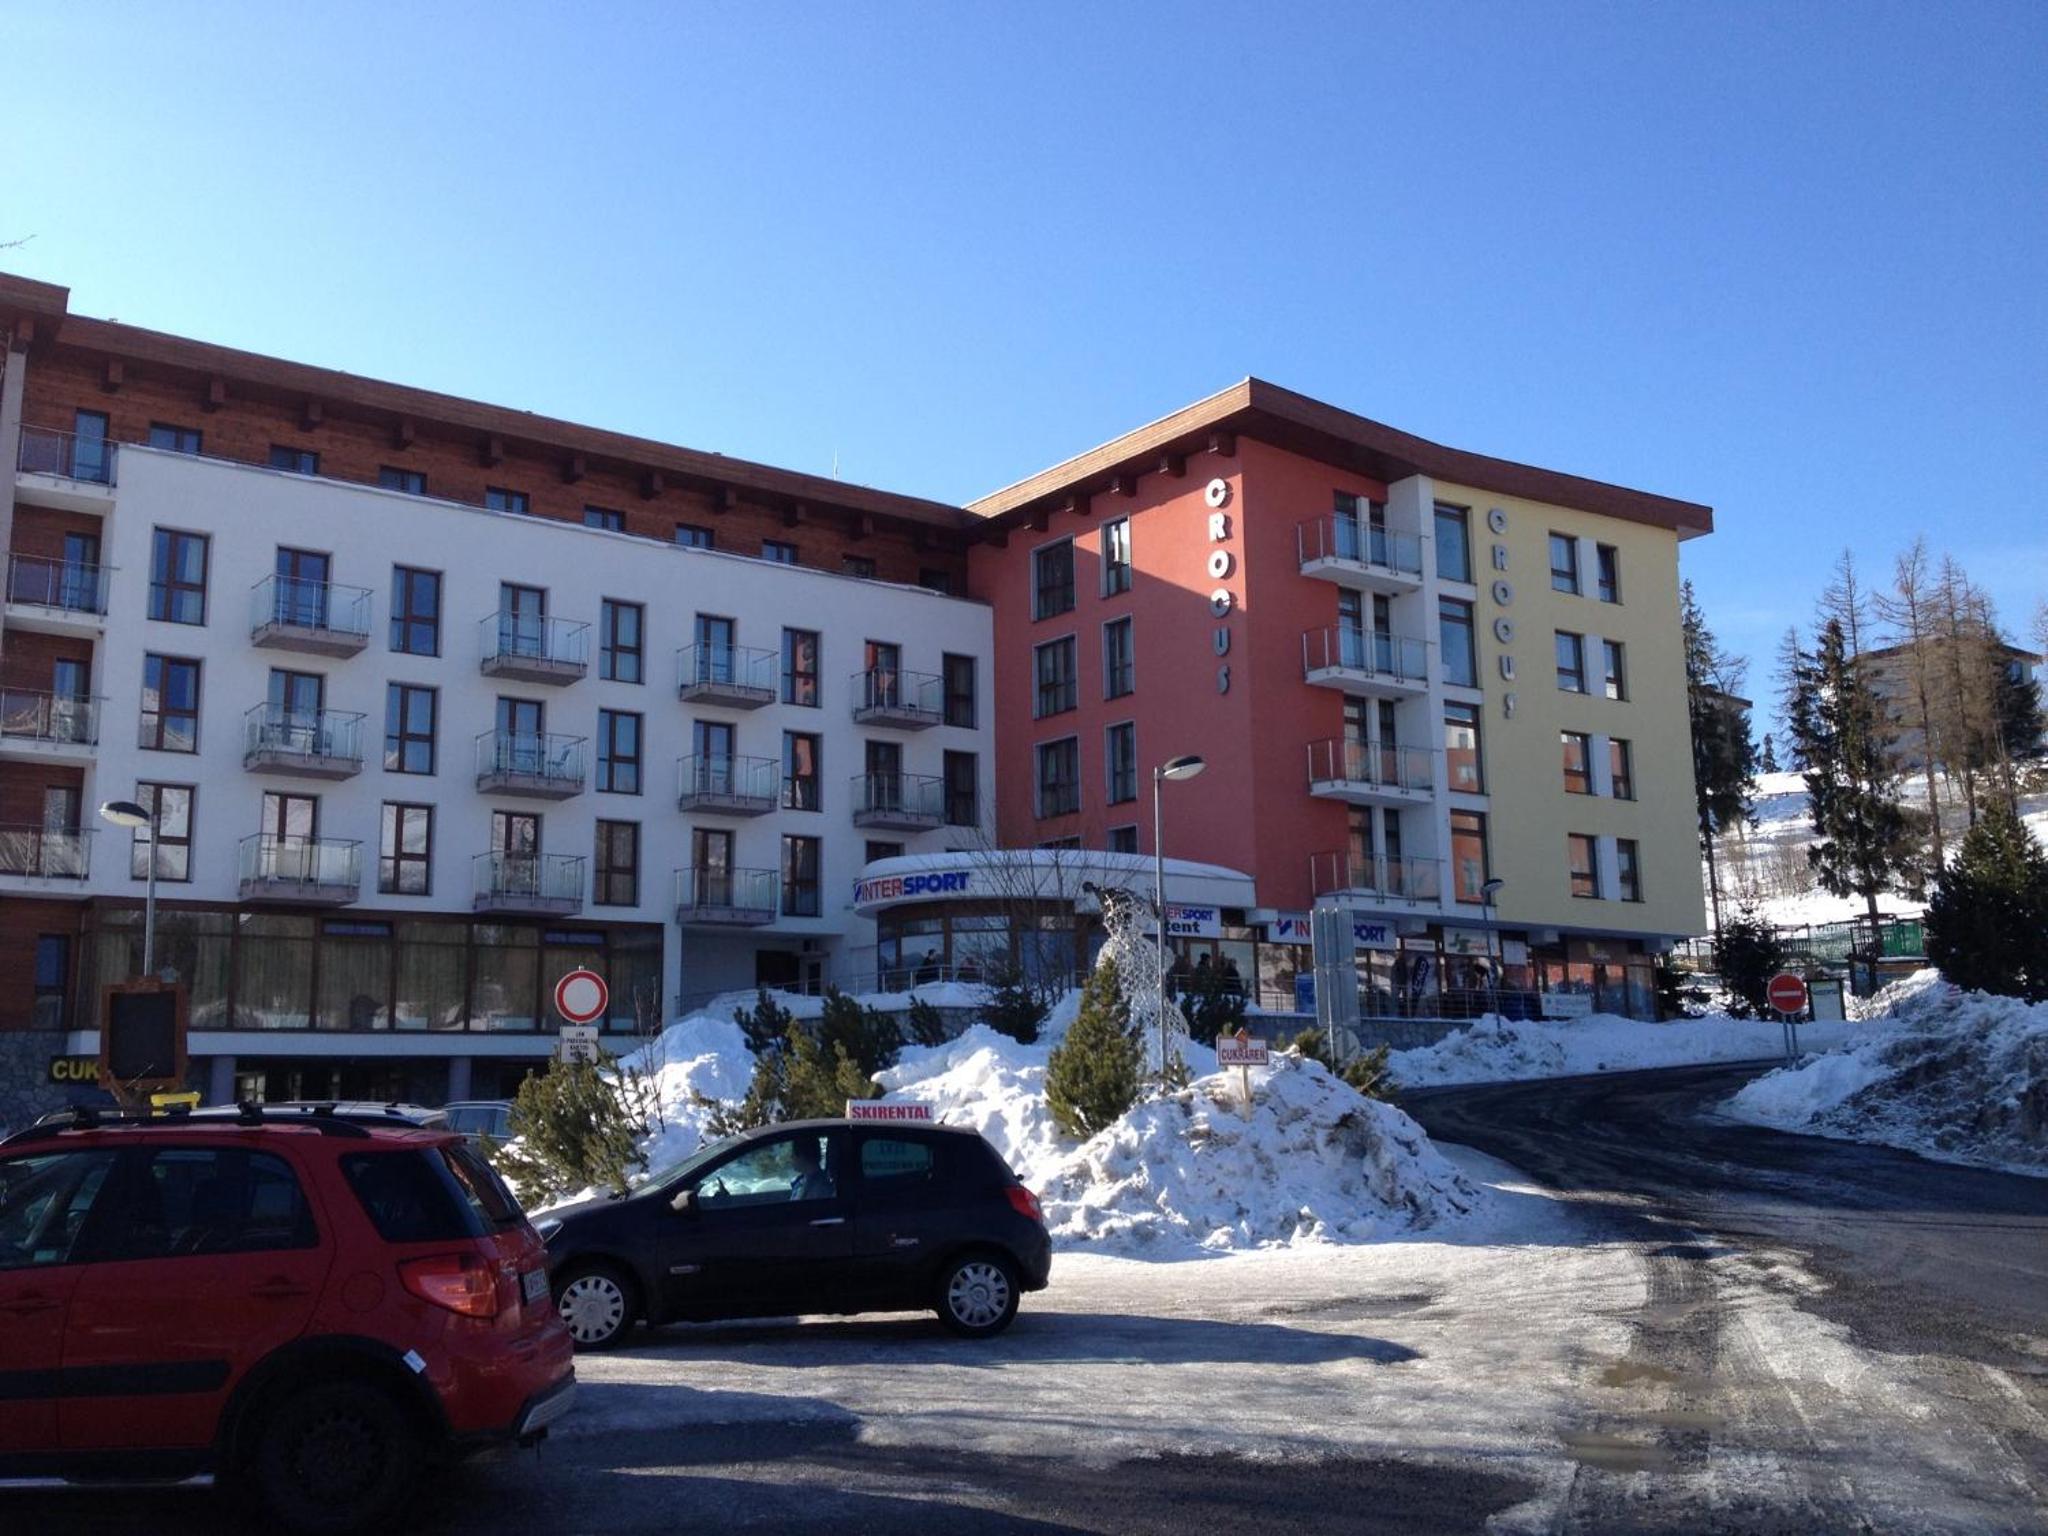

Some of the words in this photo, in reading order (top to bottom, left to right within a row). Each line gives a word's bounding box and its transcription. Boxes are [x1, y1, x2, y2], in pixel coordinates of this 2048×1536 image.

[1204, 478, 1231, 695] CROCUS
[860, 872, 970, 902] INTERSPORT
[852, 1105, 932, 1119] SKIRENTAL
